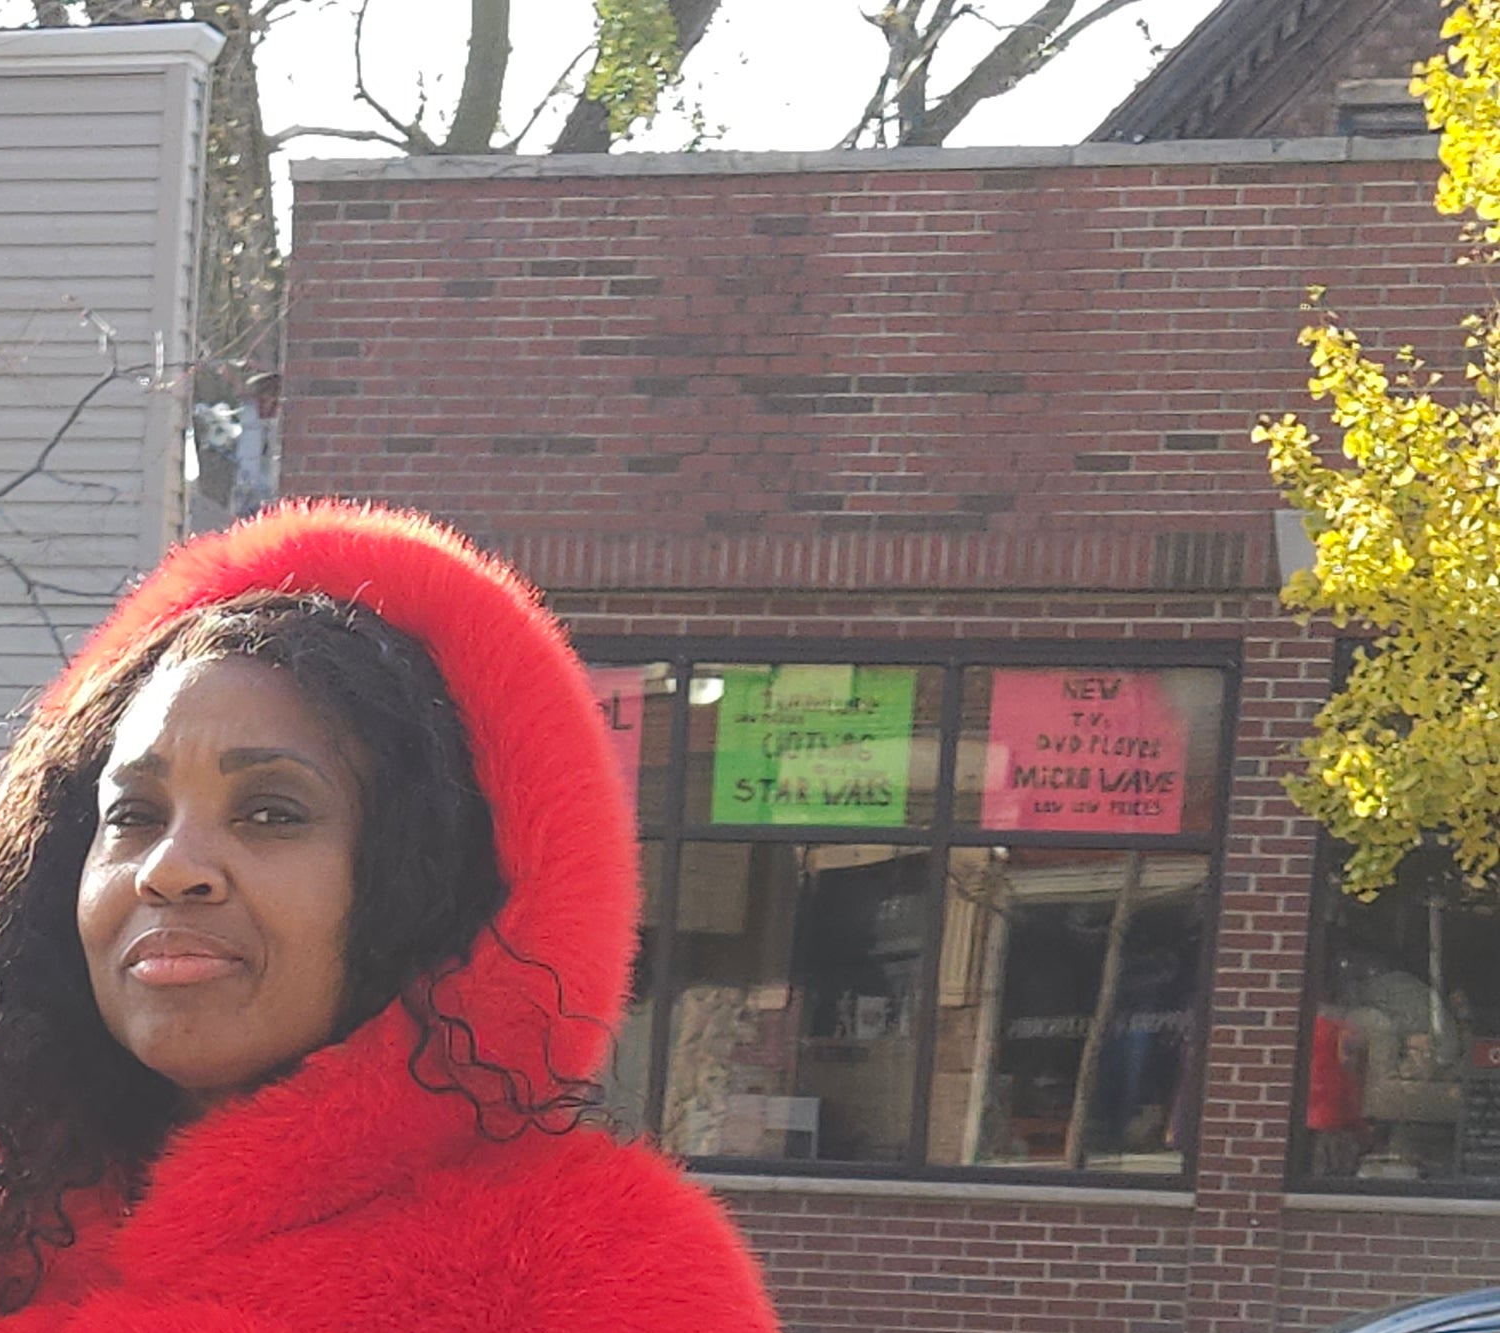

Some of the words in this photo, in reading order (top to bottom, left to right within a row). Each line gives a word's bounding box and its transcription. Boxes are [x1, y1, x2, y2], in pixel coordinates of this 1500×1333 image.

[1063, 678, 1122, 700] NEW
[1036, 733, 1083, 755] DVD
[733, 777, 810, 806] STAR
[1099, 767, 1181, 795] WAVE
